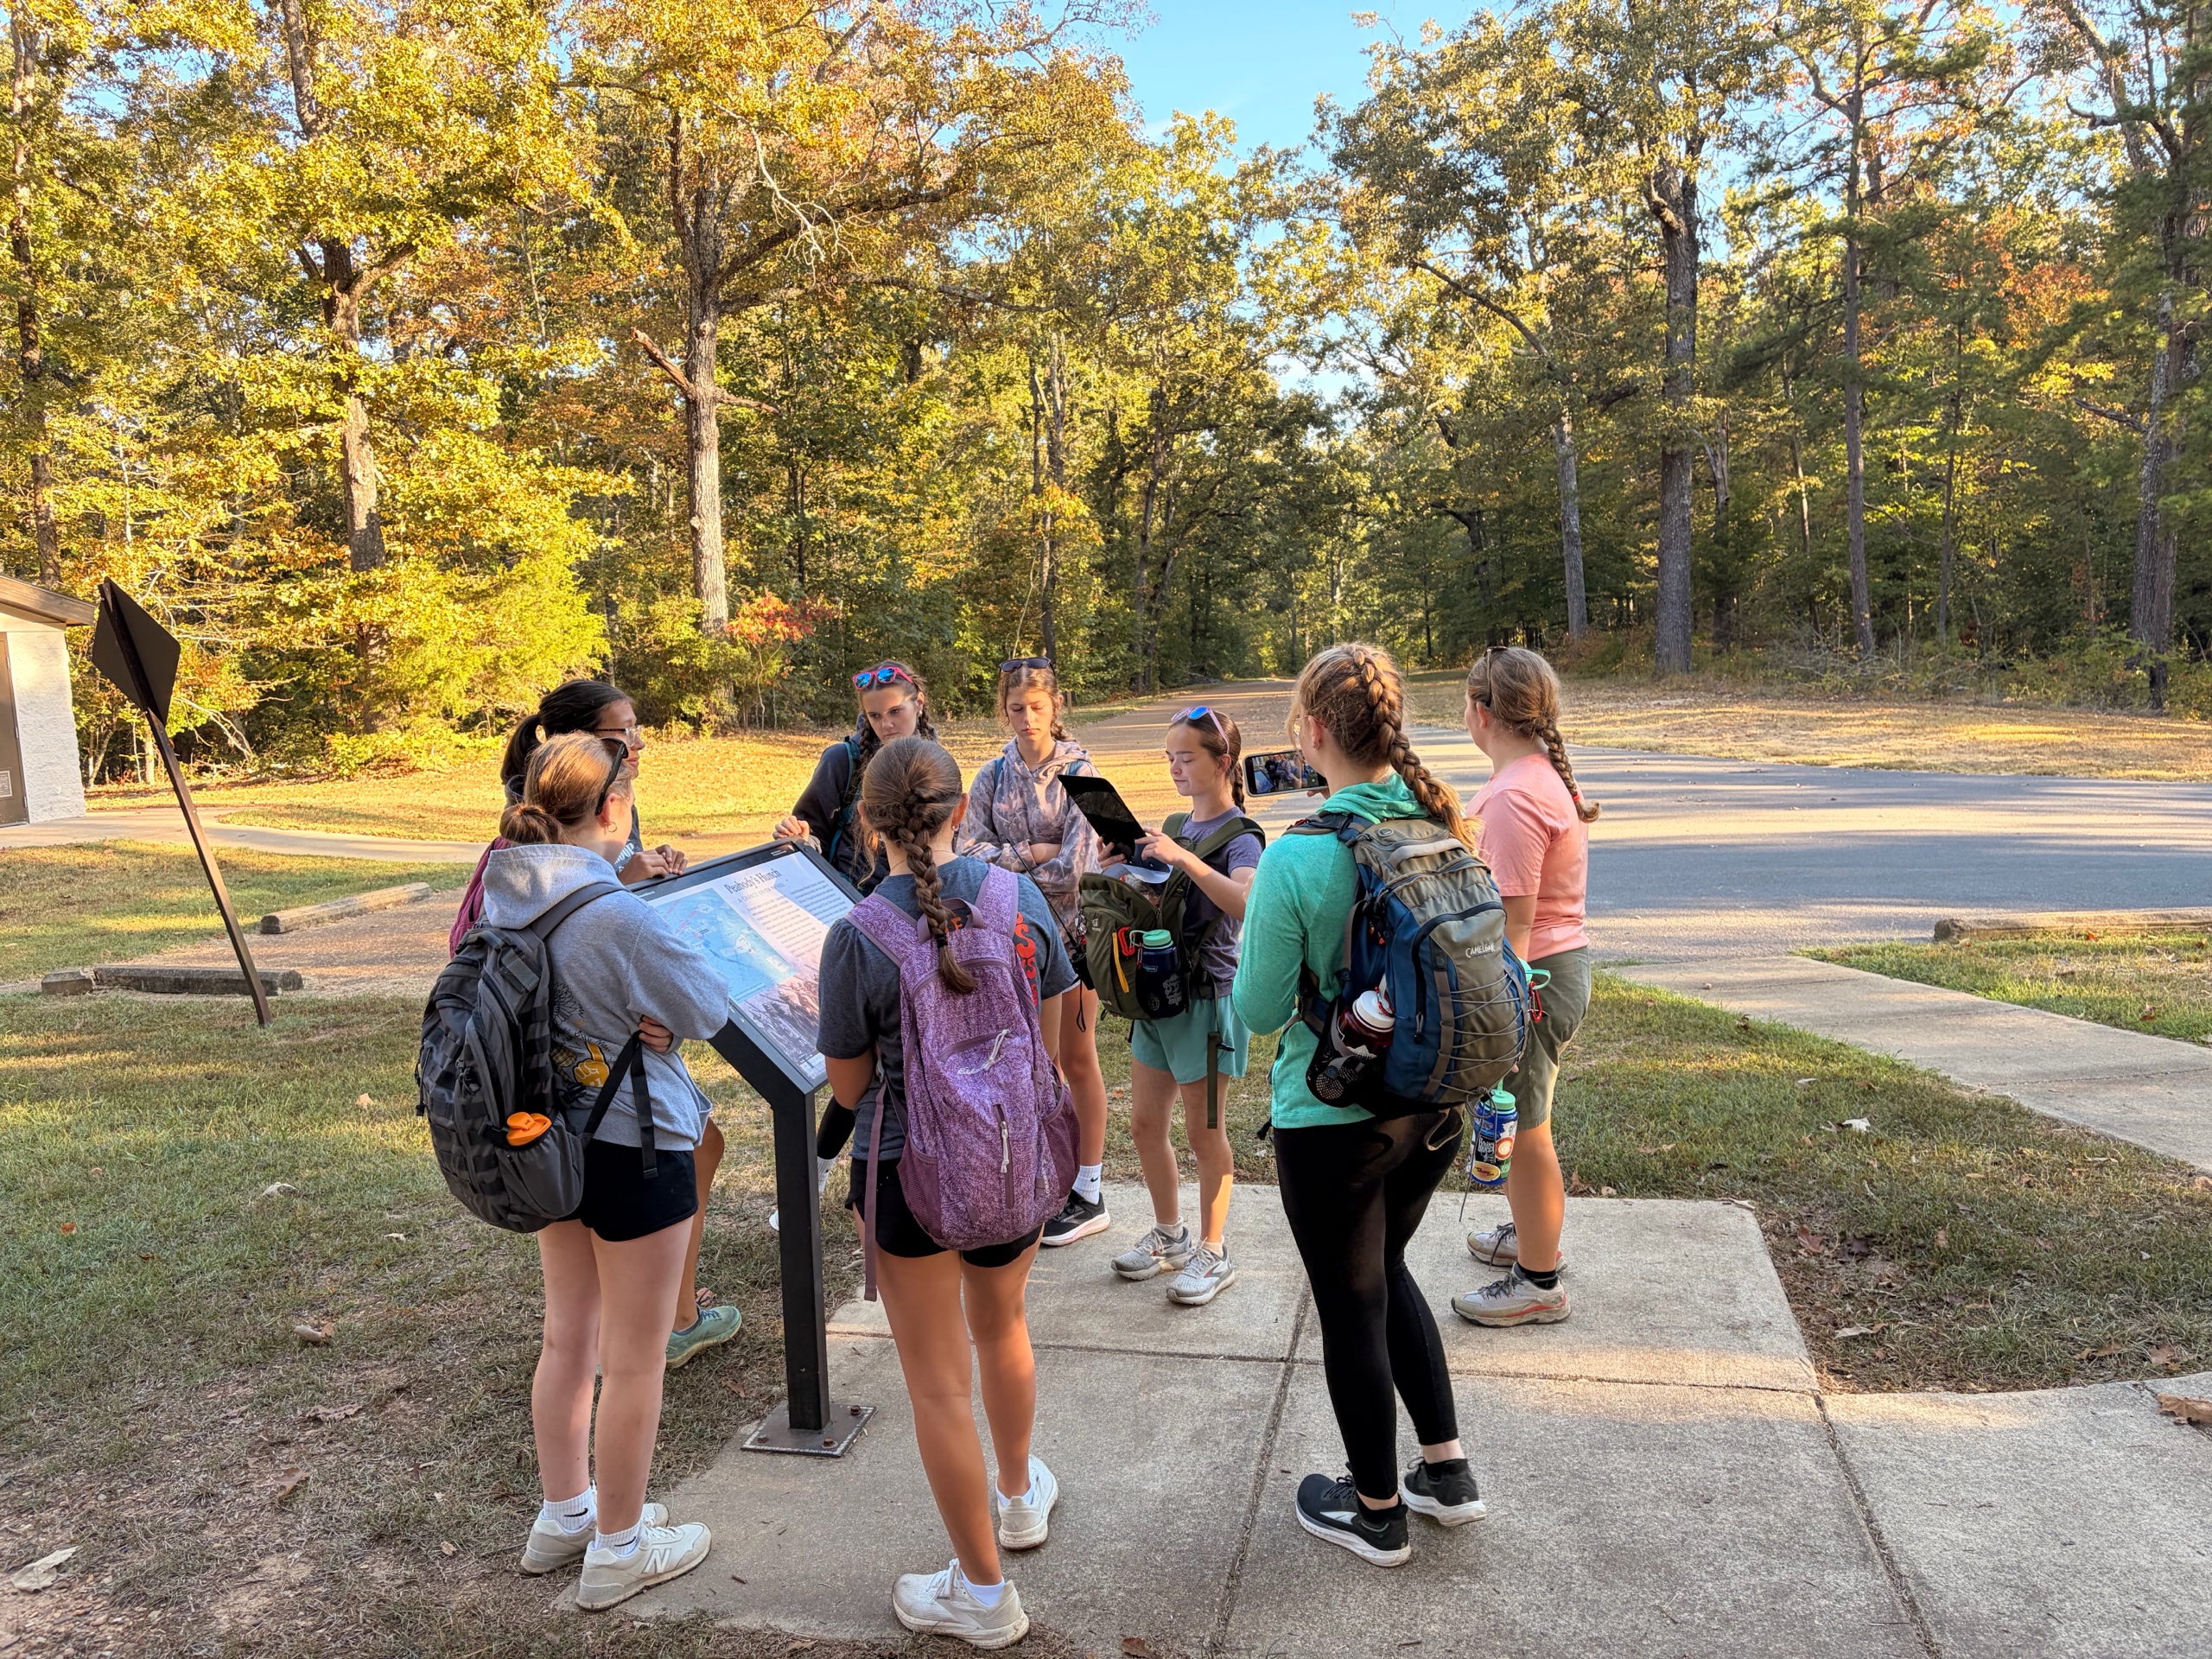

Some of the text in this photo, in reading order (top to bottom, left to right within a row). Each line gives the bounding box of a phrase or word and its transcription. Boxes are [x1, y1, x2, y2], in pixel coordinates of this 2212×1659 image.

[724, 868, 782, 893] Peabody's Hunch
[641, 1548, 672, 1574] N
